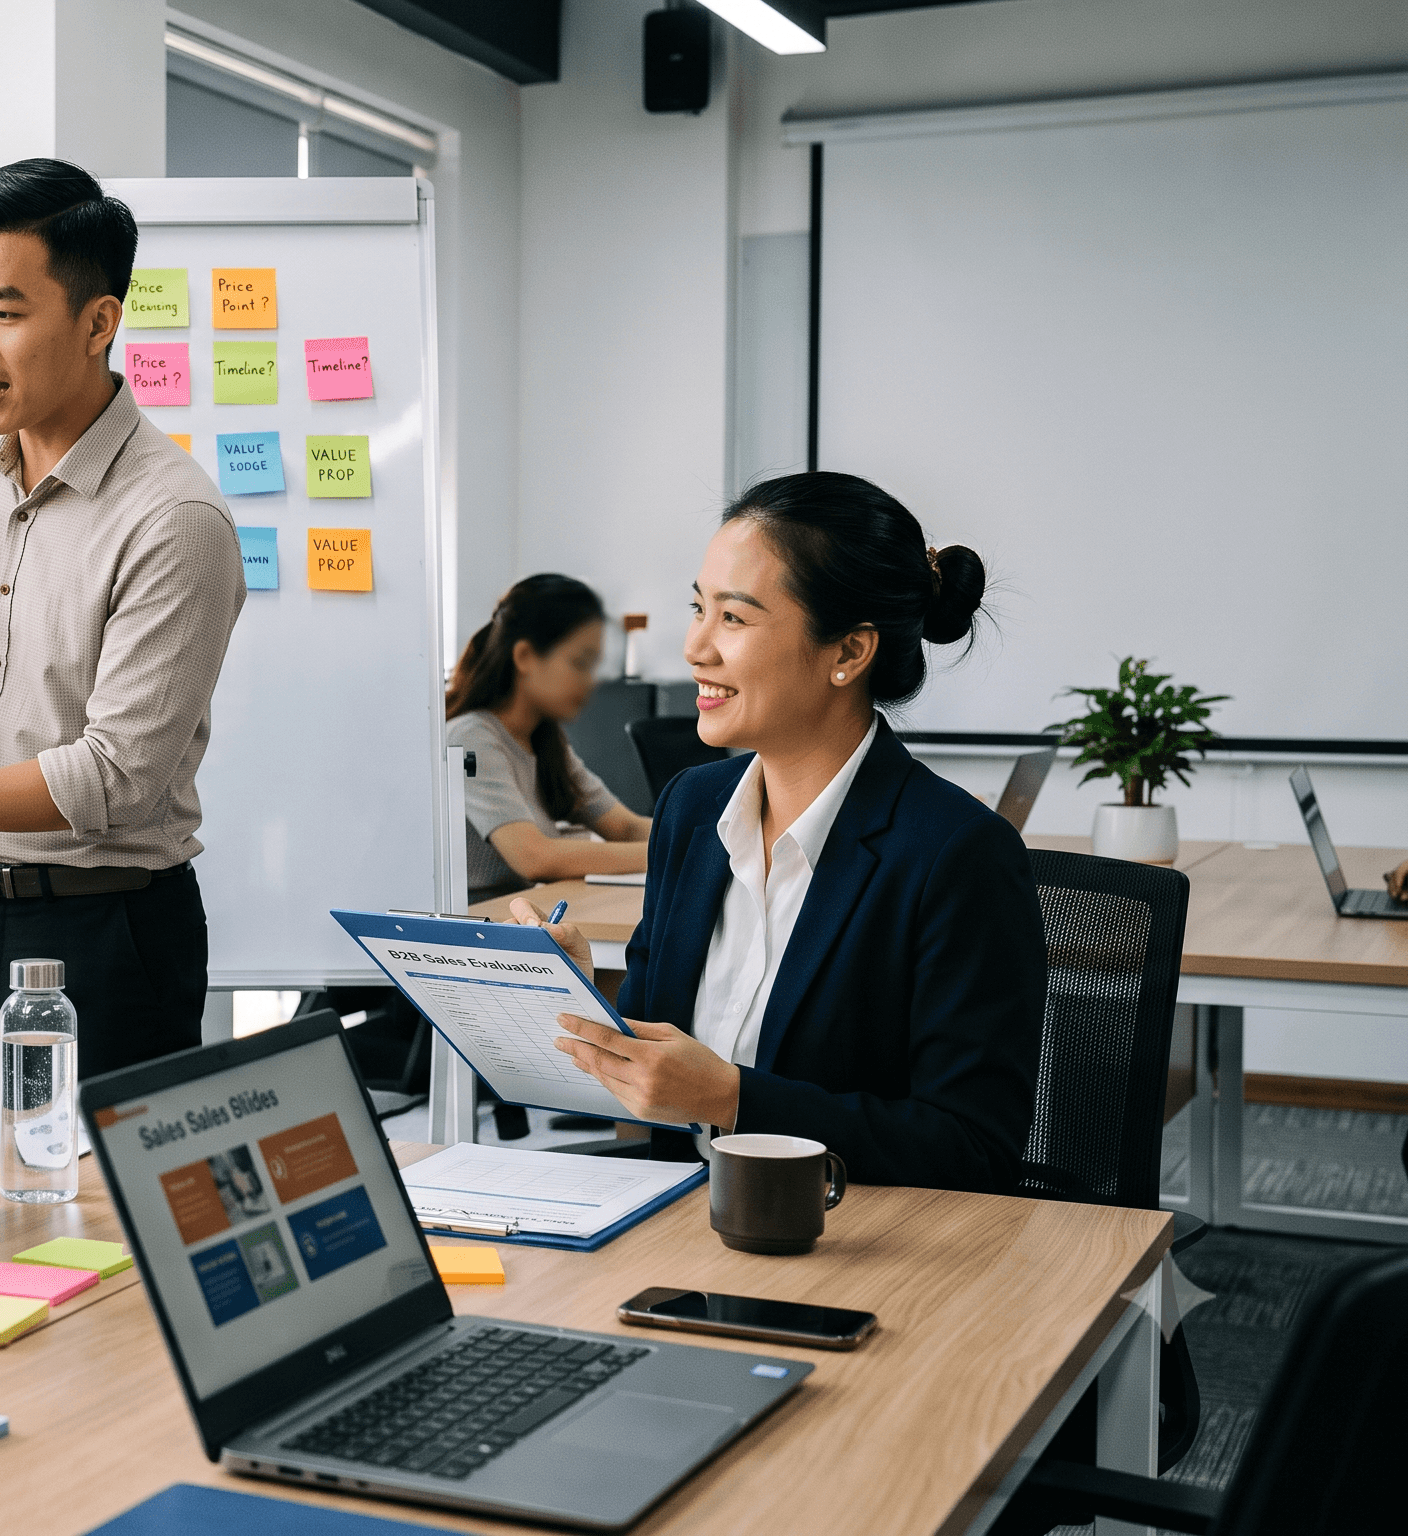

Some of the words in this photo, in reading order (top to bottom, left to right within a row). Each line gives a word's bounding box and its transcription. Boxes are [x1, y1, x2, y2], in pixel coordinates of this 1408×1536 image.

[130, 279, 163, 293] Price
[218, 278, 254, 292] Price
[222, 298, 255, 313] Point
[133, 353, 167, 368] Price
[307, 356, 368, 373] Timeline?
[214, 360, 275, 376] Timeline?
[134, 373, 168, 388] Point
[224, 443, 265, 455] VALUE
[311, 449, 357, 462] VALUE
[318, 468, 355, 482] PROP
[313, 539, 358, 552] VALUE
[318, 558, 355, 571] PROP
[387, 949, 422, 963] B2B
[423, 953, 468, 968] Sales
[467, 957, 555, 976] Evaluation
[138, 1120, 187, 1151] Sales
[184, 1105, 231, 1134] Sales
